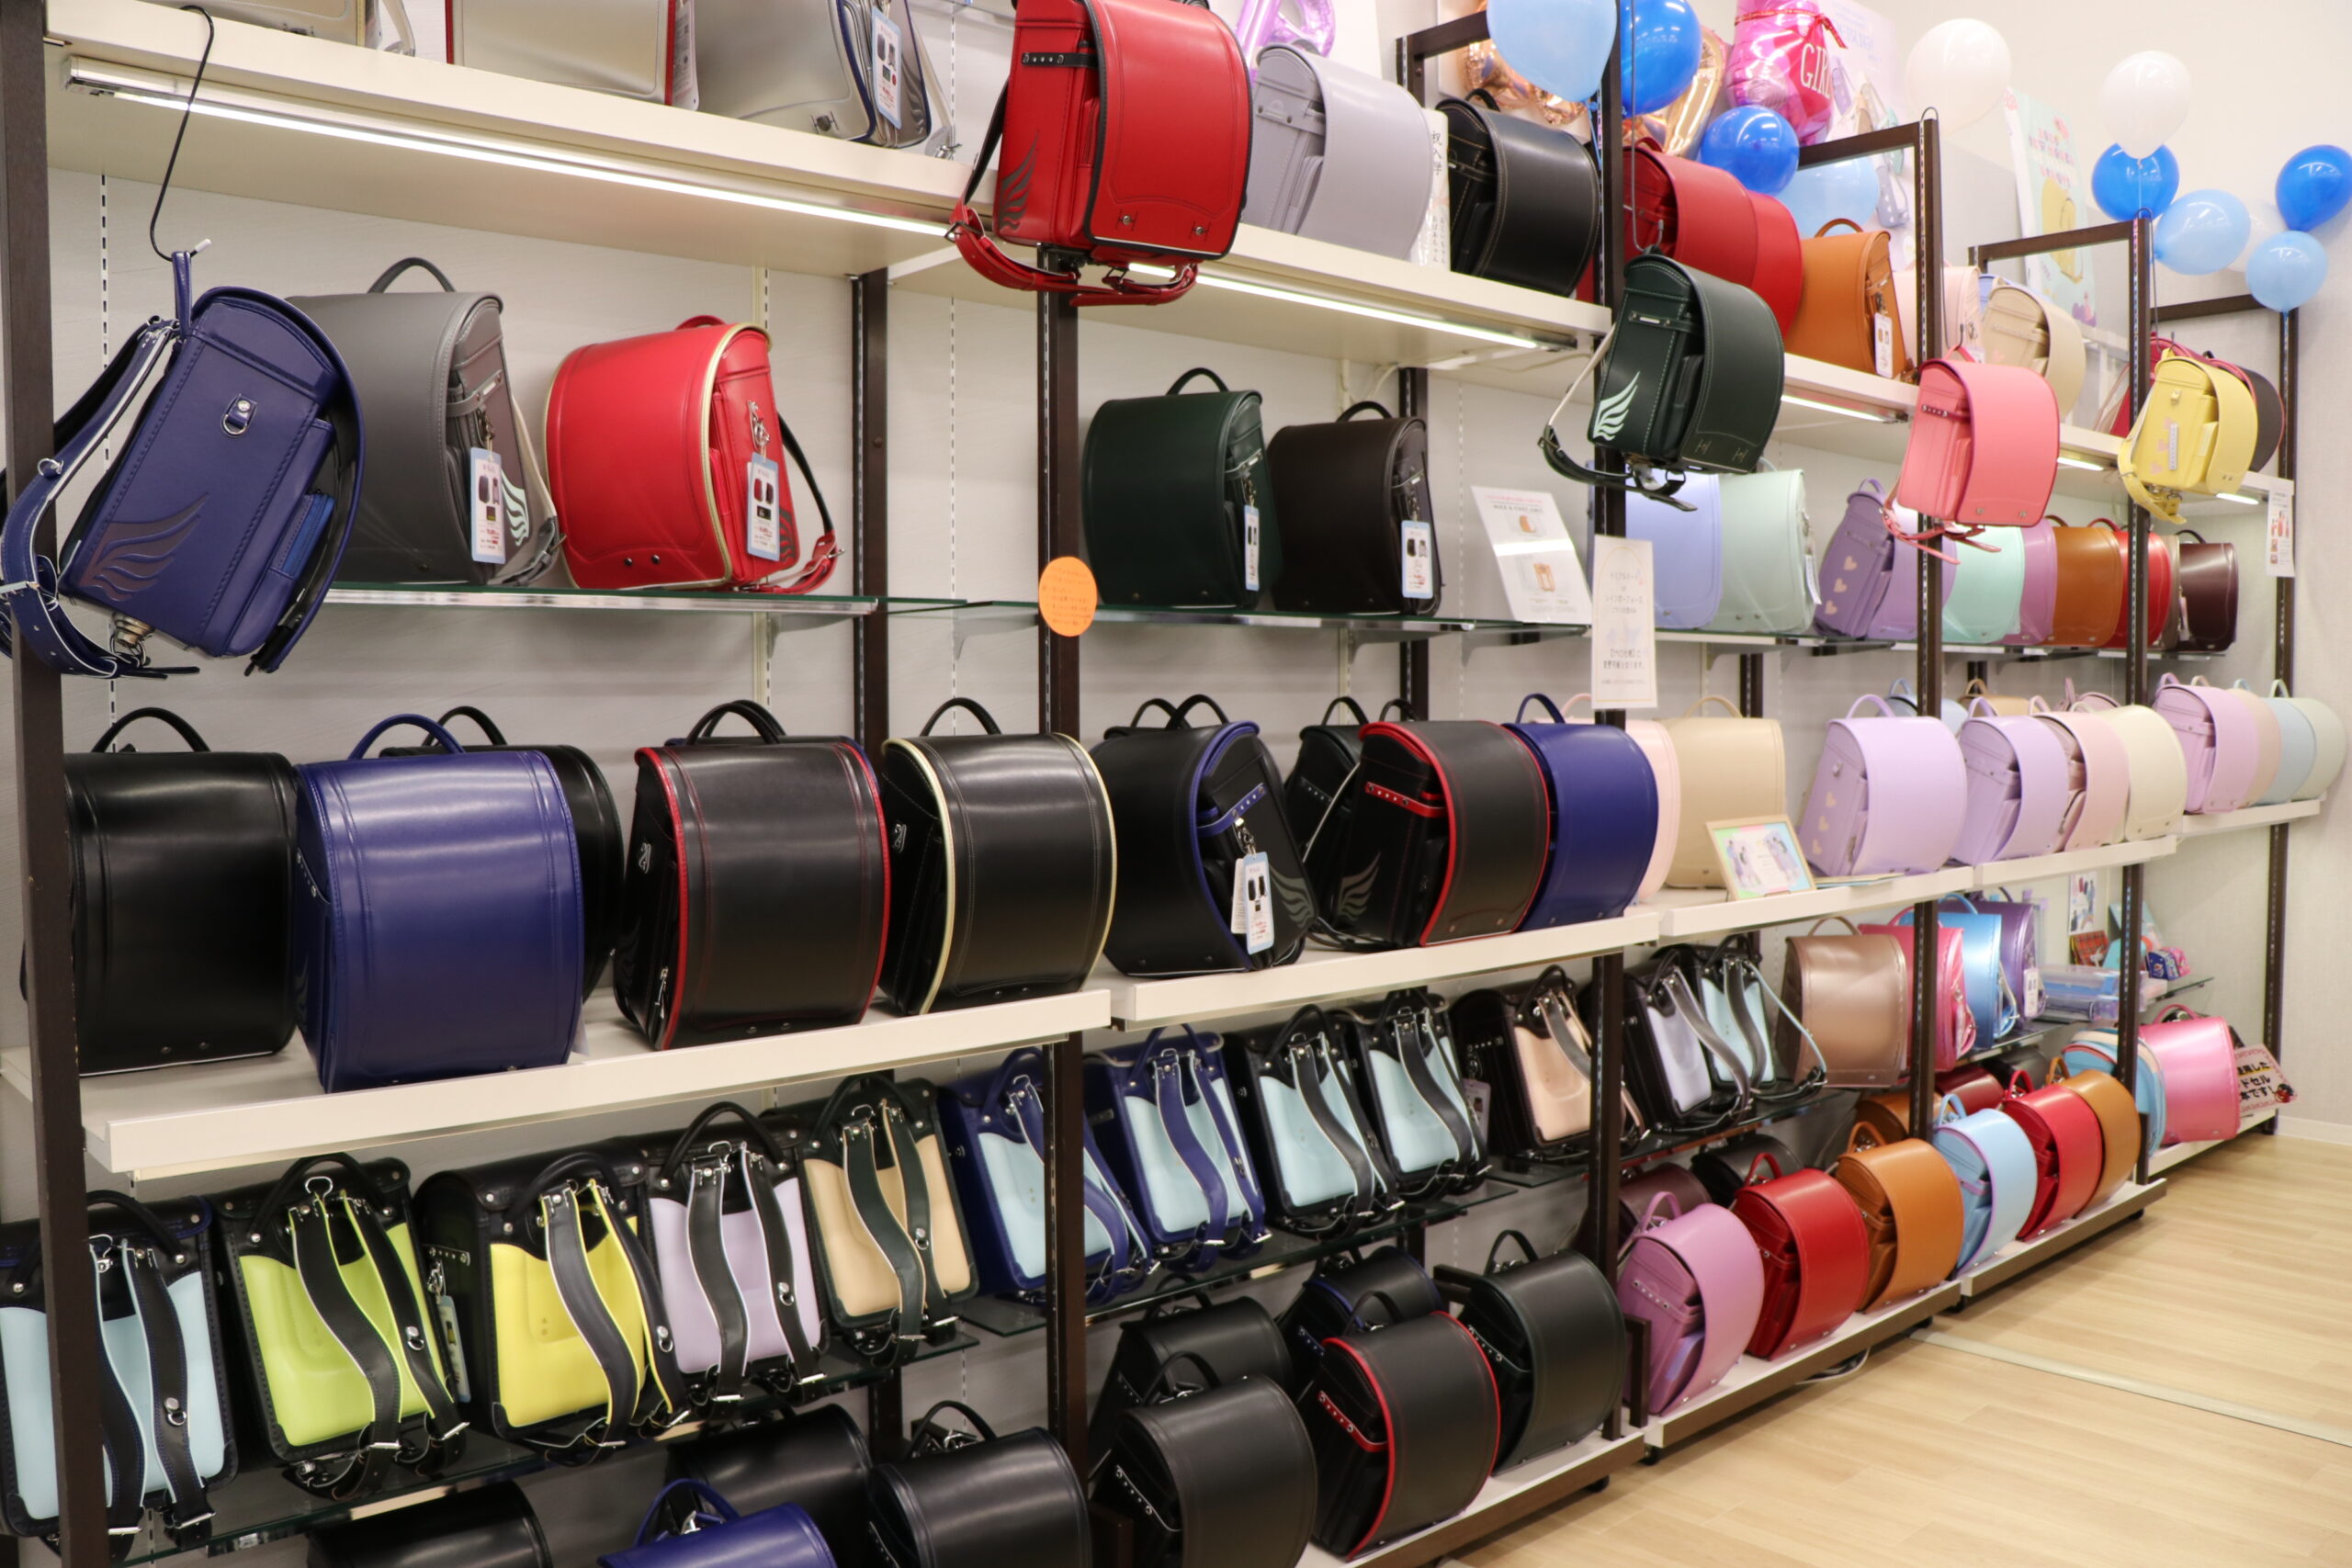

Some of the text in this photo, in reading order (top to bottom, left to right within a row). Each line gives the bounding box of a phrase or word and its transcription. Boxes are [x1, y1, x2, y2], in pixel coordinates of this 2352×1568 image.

[1800, 42, 1831, 99] GIRL
[2238, 1075, 2270, 1089] ドセル
